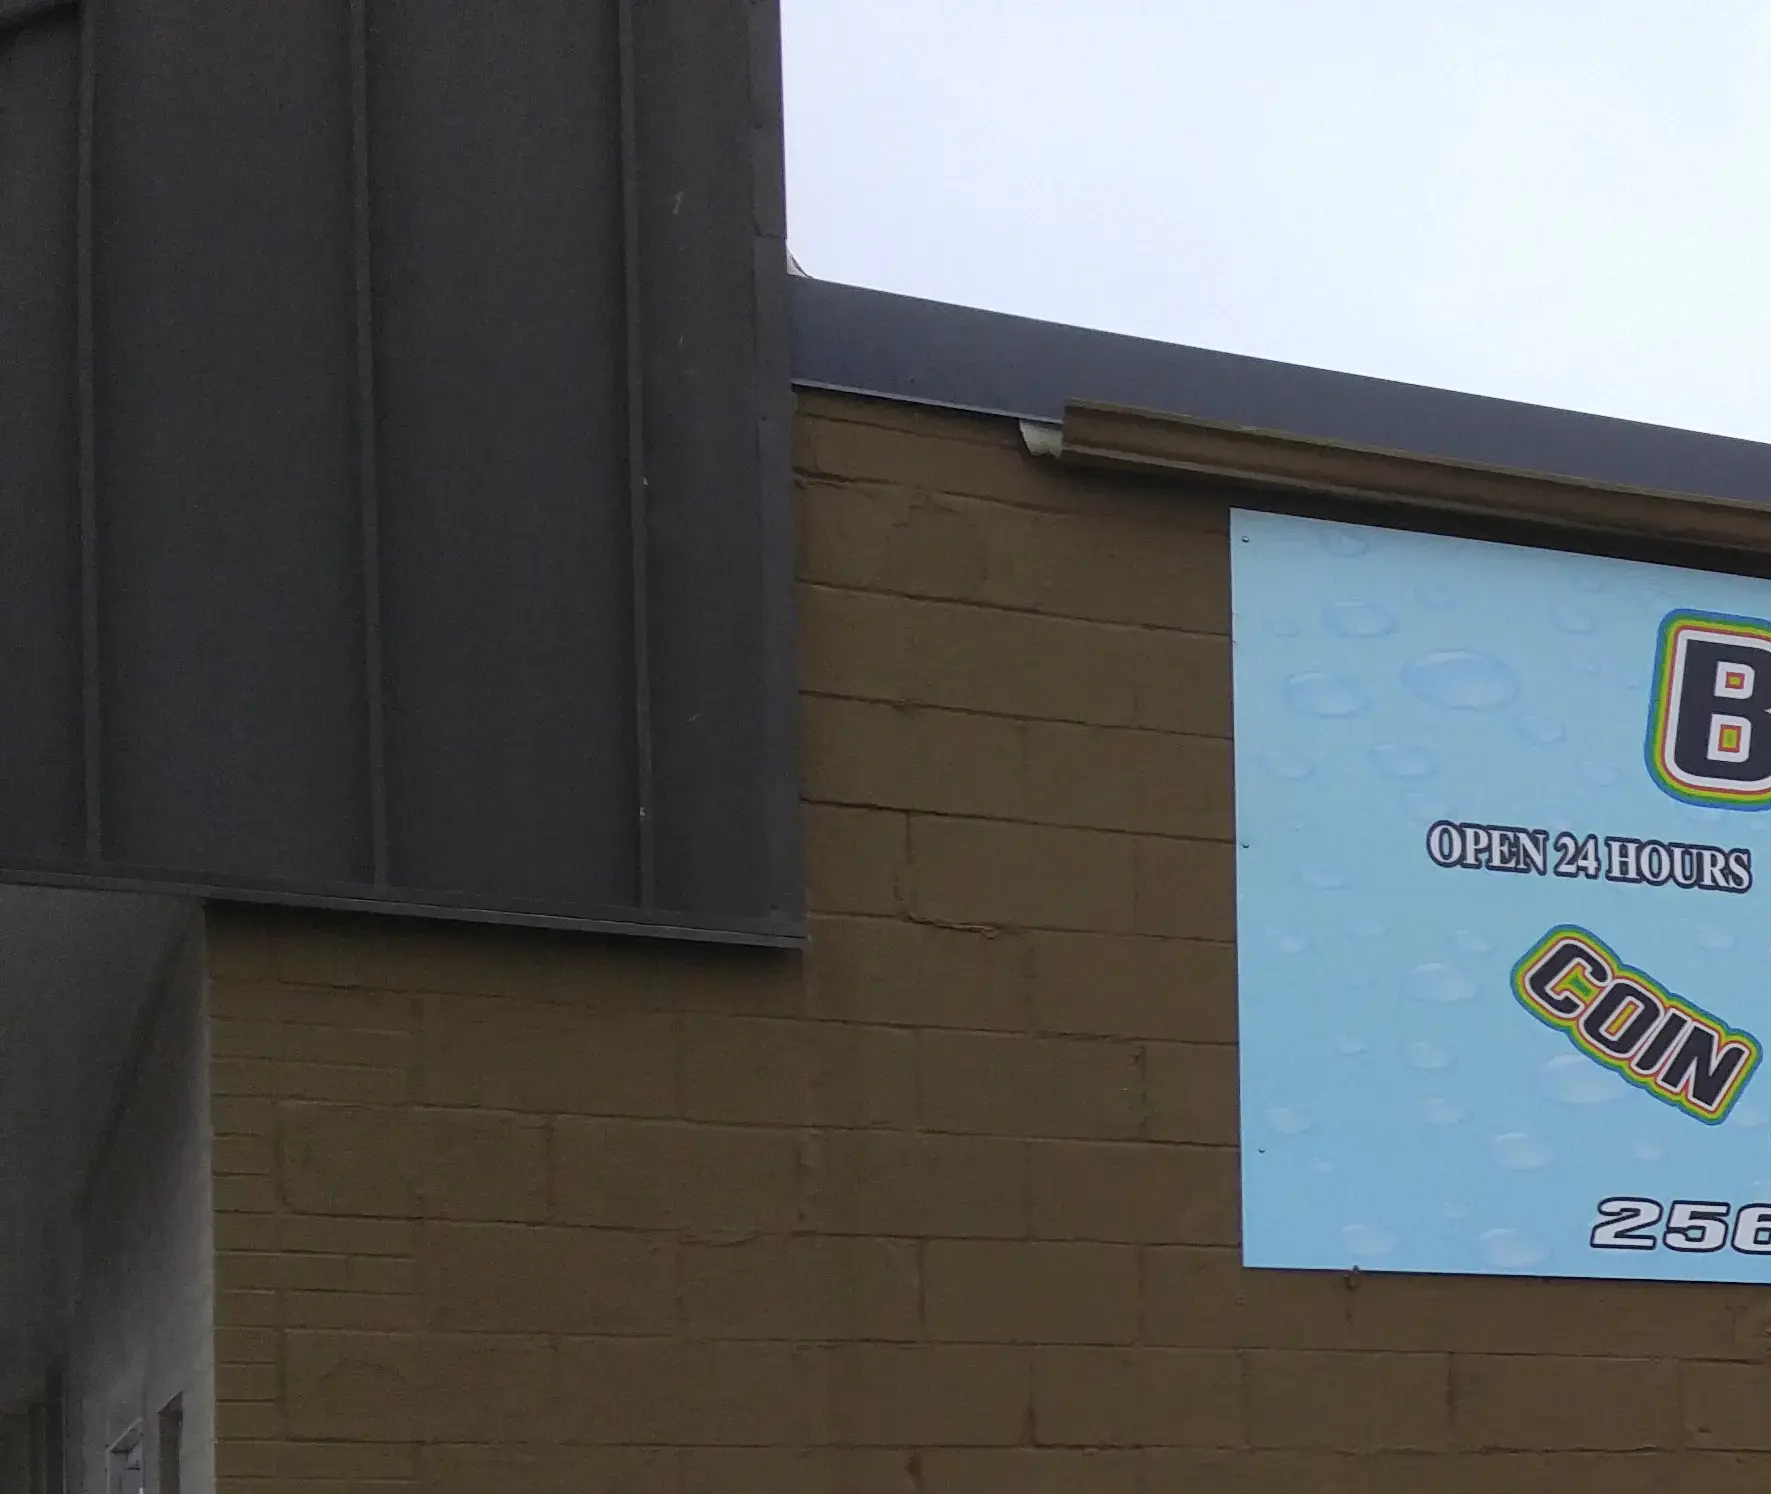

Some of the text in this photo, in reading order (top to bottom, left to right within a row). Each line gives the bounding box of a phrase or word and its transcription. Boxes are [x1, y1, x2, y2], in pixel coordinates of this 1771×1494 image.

[1428, 820, 1752, 894] OPEN 24 HOURS
[1516, 930, 1757, 1119] COIN
